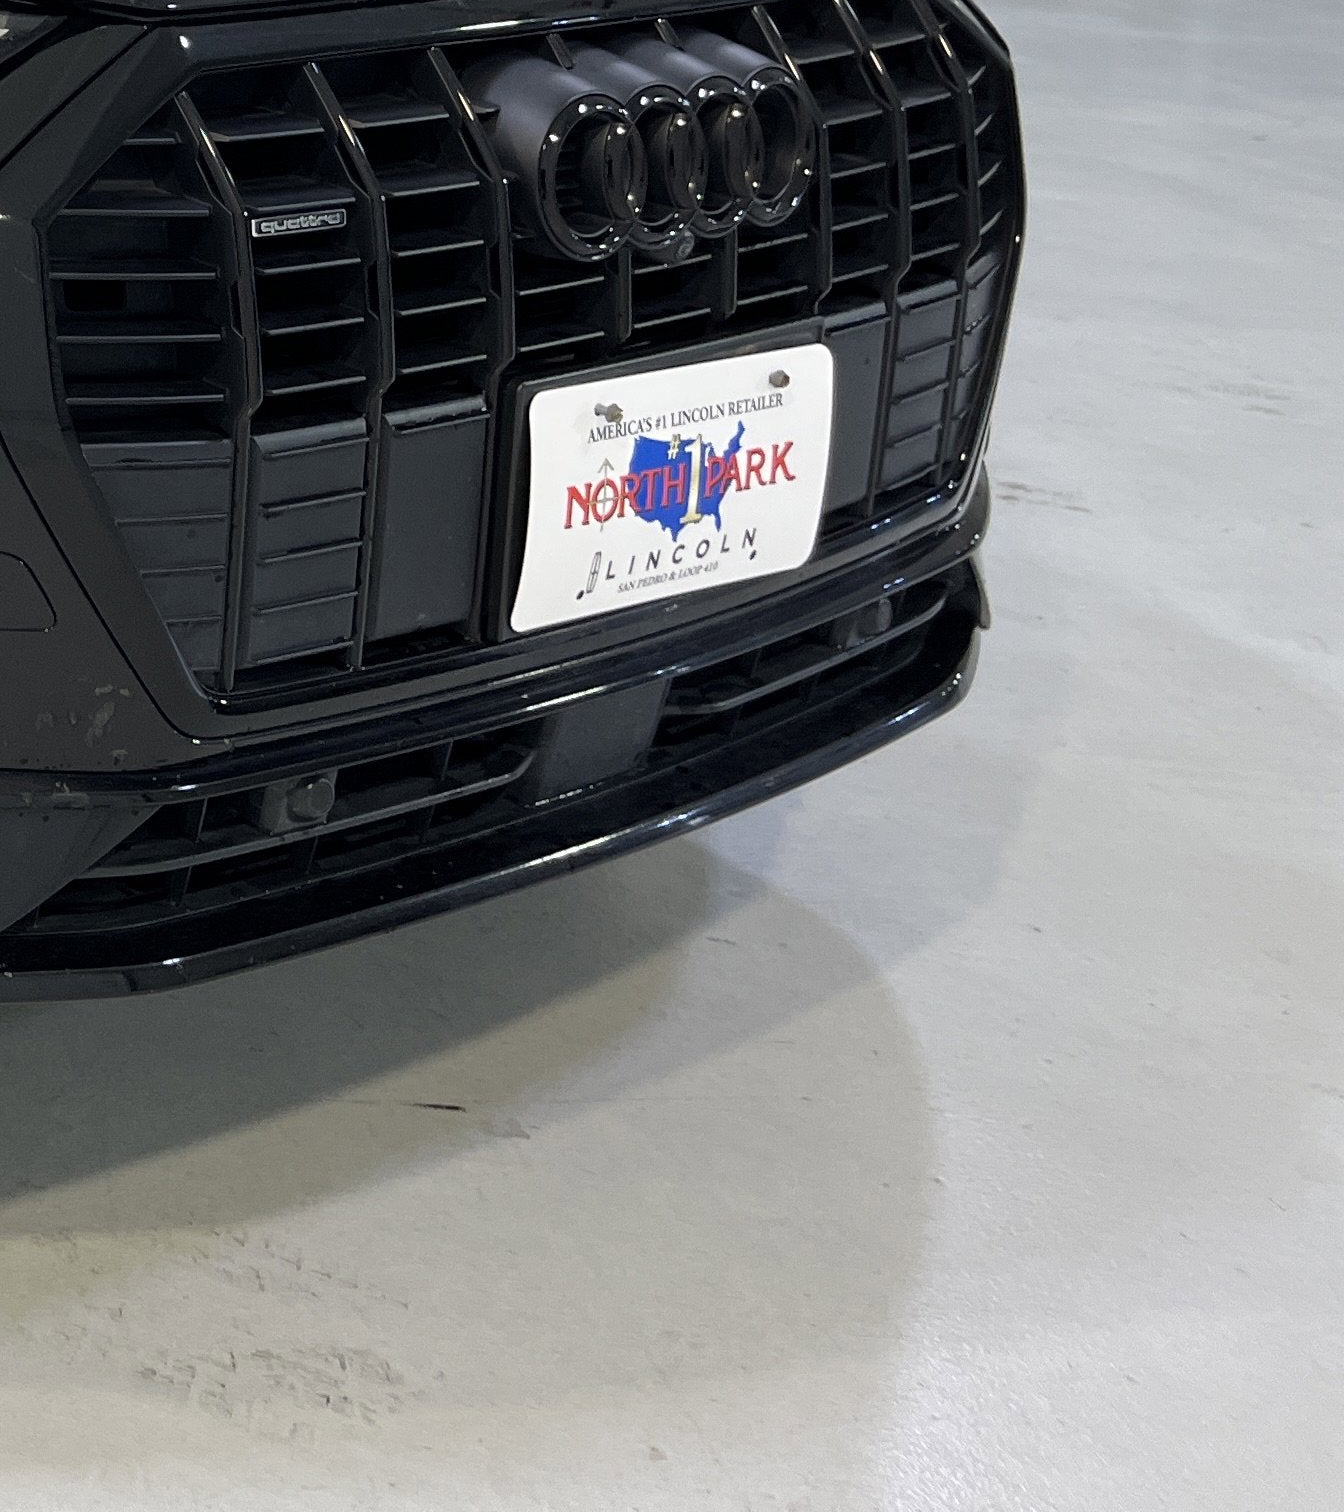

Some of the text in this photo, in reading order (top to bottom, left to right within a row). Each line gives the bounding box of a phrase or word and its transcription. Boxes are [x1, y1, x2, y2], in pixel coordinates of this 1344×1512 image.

[260, 213, 341, 234] quattro
[588, 393, 783, 444] AMERICA'S #1 LINCOLN RETAILER
[563, 440, 797, 529] NORTH PARK
[605, 528, 758, 581] LINCOLN
[617, 561, 719, 594] SAN PEDRO & LOOP 410
